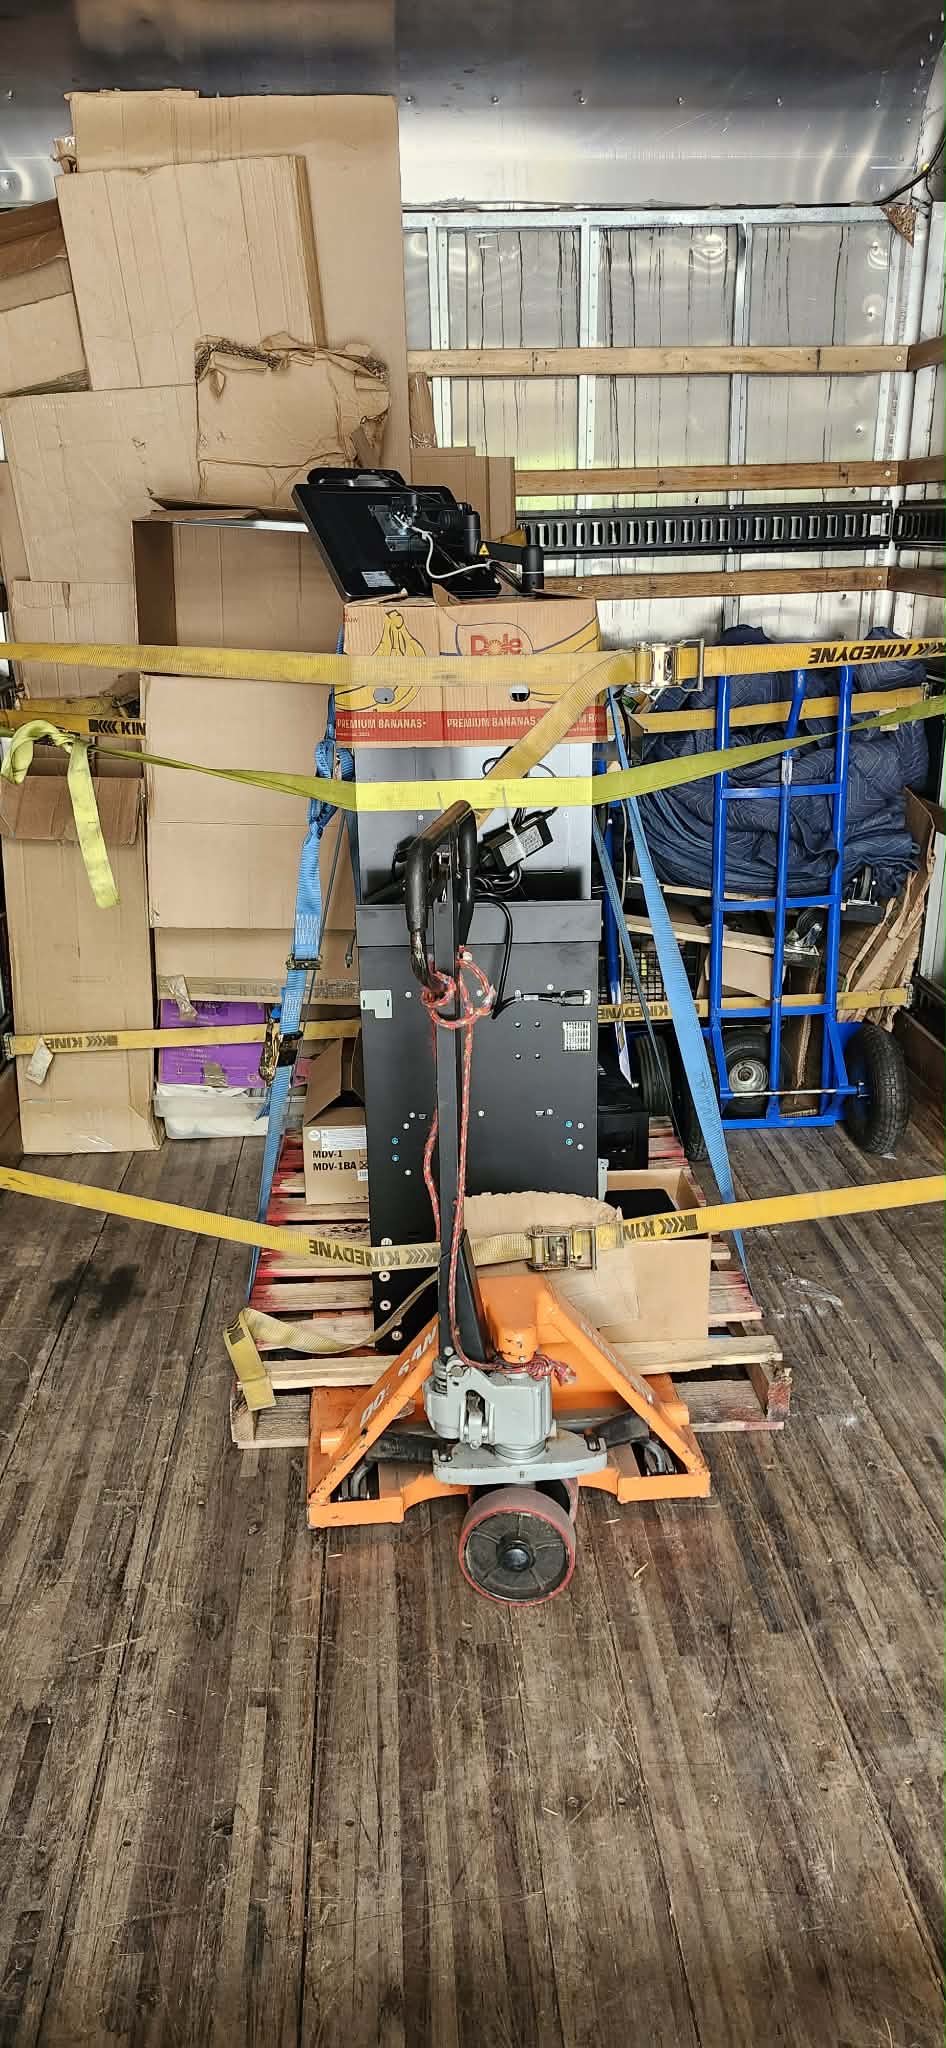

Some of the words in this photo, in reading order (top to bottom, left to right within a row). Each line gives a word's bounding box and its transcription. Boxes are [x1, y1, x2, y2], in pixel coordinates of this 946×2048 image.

[471, 633, 523, 656] Dole
[808, 643, 913, 665] KINEDYNE
[337, 718, 376, 729] PREMIUM
[378, 718, 422, 729] BANANAS
[447, 718, 490, 729] PREMIUM
[492, 715, 537, 728] BANANAS
[312, 1150, 343, 1159] MDV-1
[313, 1161, 357, 1171] MDV-1BA
[309, 1239, 400, 1267] KINEDYNE
